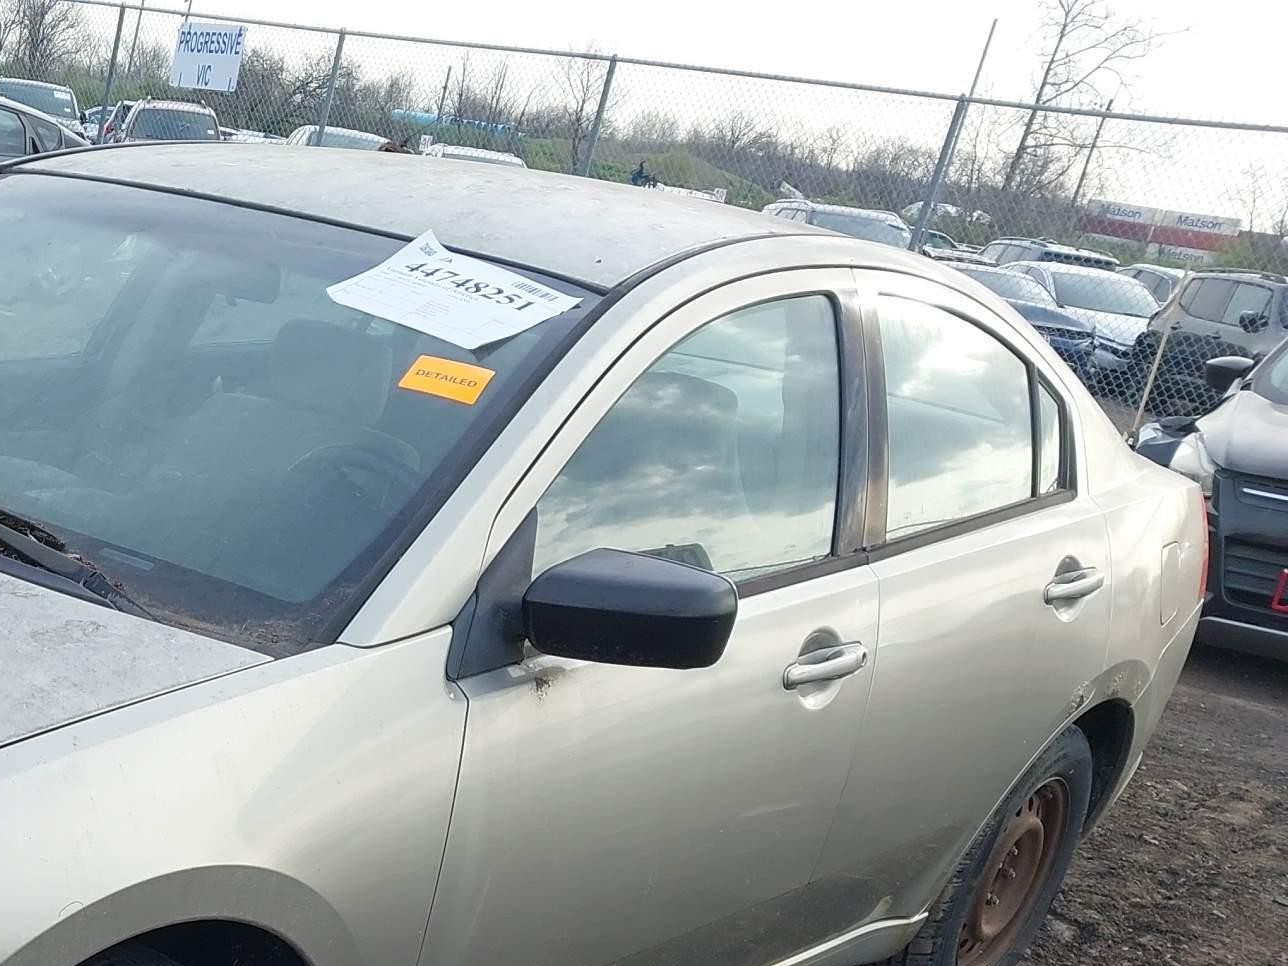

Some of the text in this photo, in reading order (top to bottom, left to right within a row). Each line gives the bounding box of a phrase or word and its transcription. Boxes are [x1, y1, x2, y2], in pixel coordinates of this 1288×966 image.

[179, 31, 243, 54] PROGRESSIVE
[197, 64, 212, 87] VIC
[1176, 215, 1224, 230] Matson
[405, 263, 535, 311] 44748251
[416, 369, 478, 388] DETAILED
